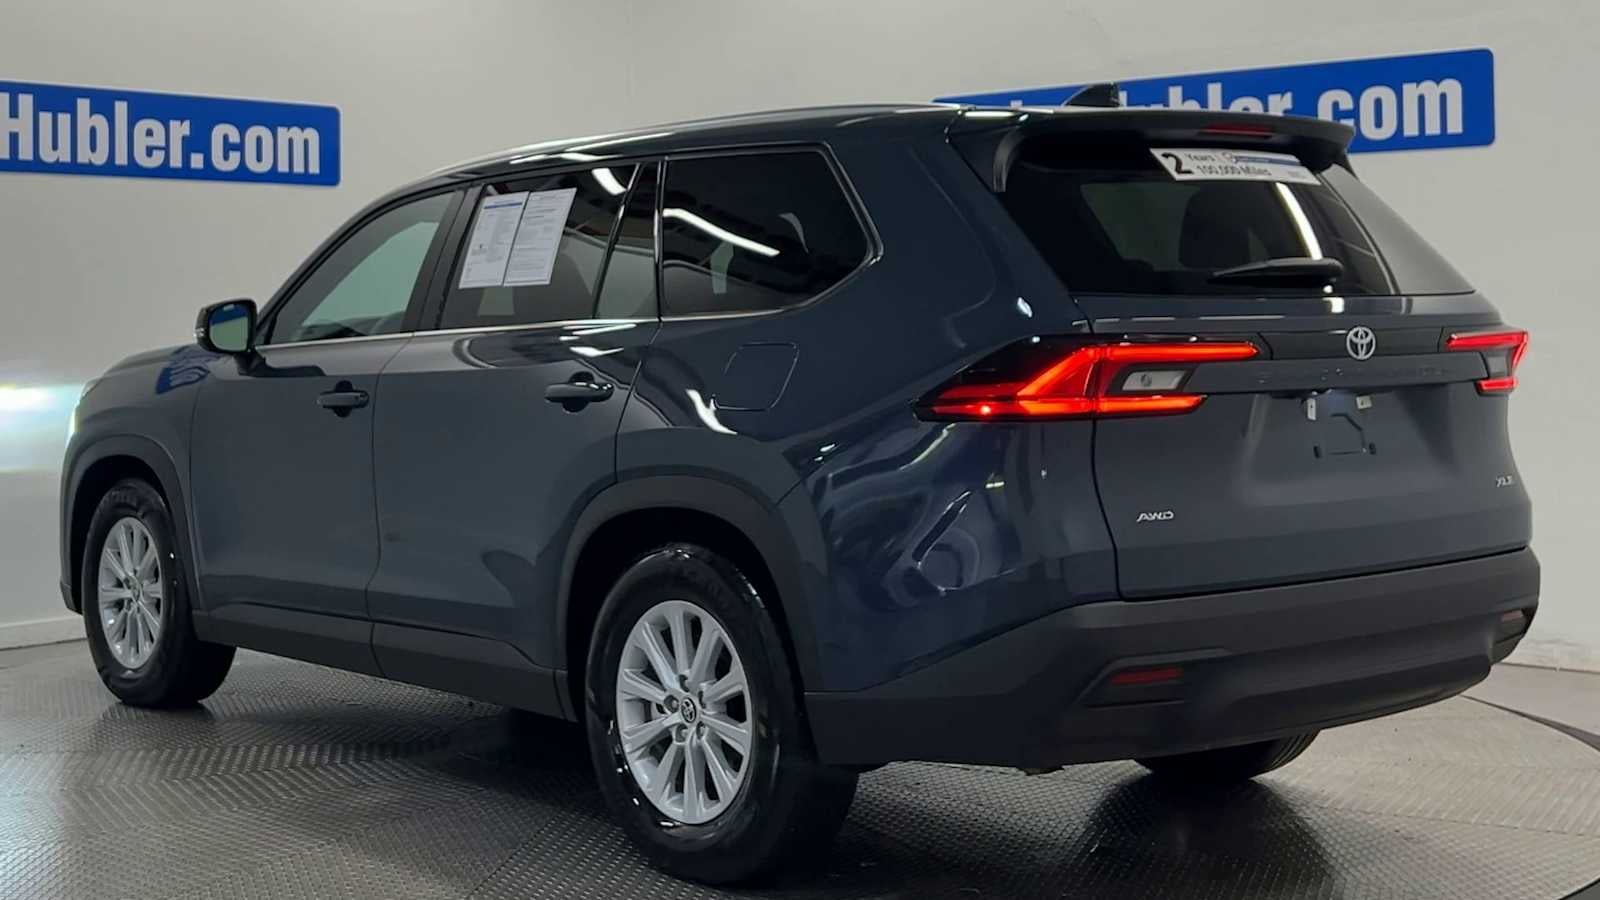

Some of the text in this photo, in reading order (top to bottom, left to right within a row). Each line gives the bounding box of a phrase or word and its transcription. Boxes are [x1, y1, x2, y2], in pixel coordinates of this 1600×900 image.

[0, 92, 320, 174] Hubler.com
[1161, 152, 1194, 175] 2
[1136, 510, 1174, 522] AWD
